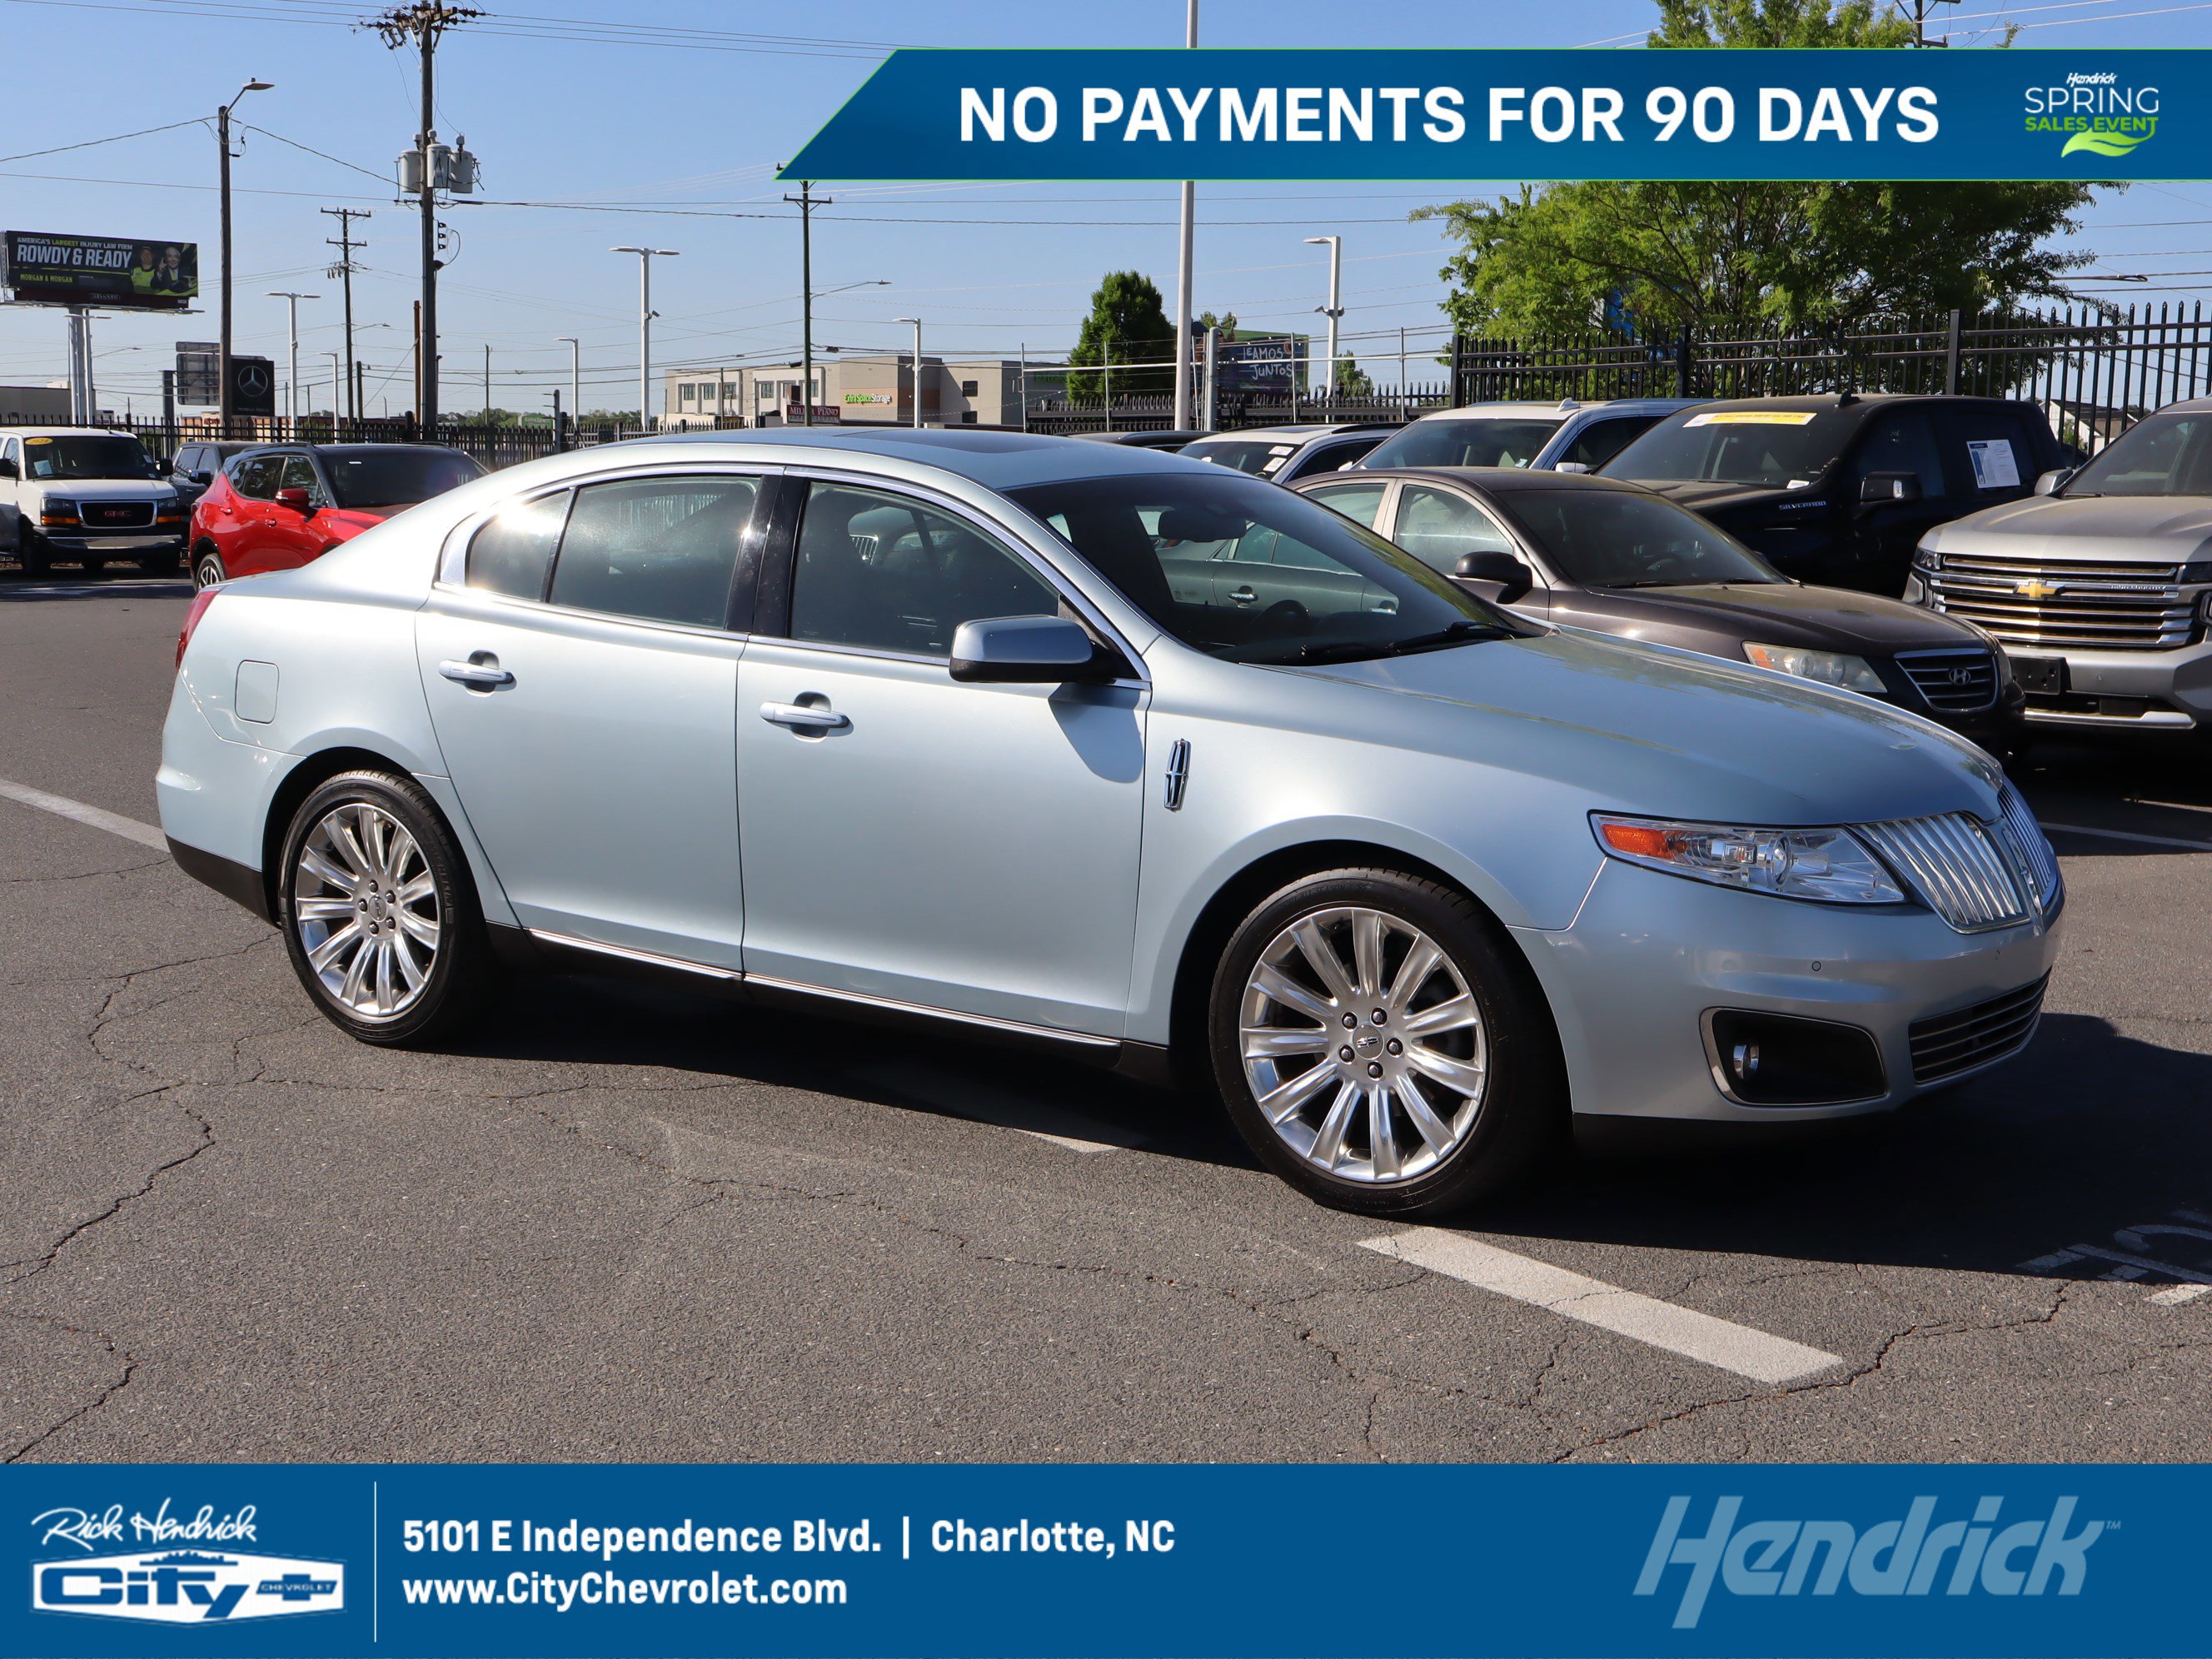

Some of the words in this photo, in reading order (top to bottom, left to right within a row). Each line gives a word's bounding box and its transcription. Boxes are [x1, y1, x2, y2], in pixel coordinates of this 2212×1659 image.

[17, 237, 51, 245] AMERICA'S
[52, 239, 79, 247] LARGEST
[17, 244, 71, 265] ROWDY
[72, 248, 82, 266] &
[85, 249, 132, 268] READY
[20, 274, 44, 282] MORGAN
[50, 275, 73, 283] MORGAN
[817, 406, 839, 416] PIANO
